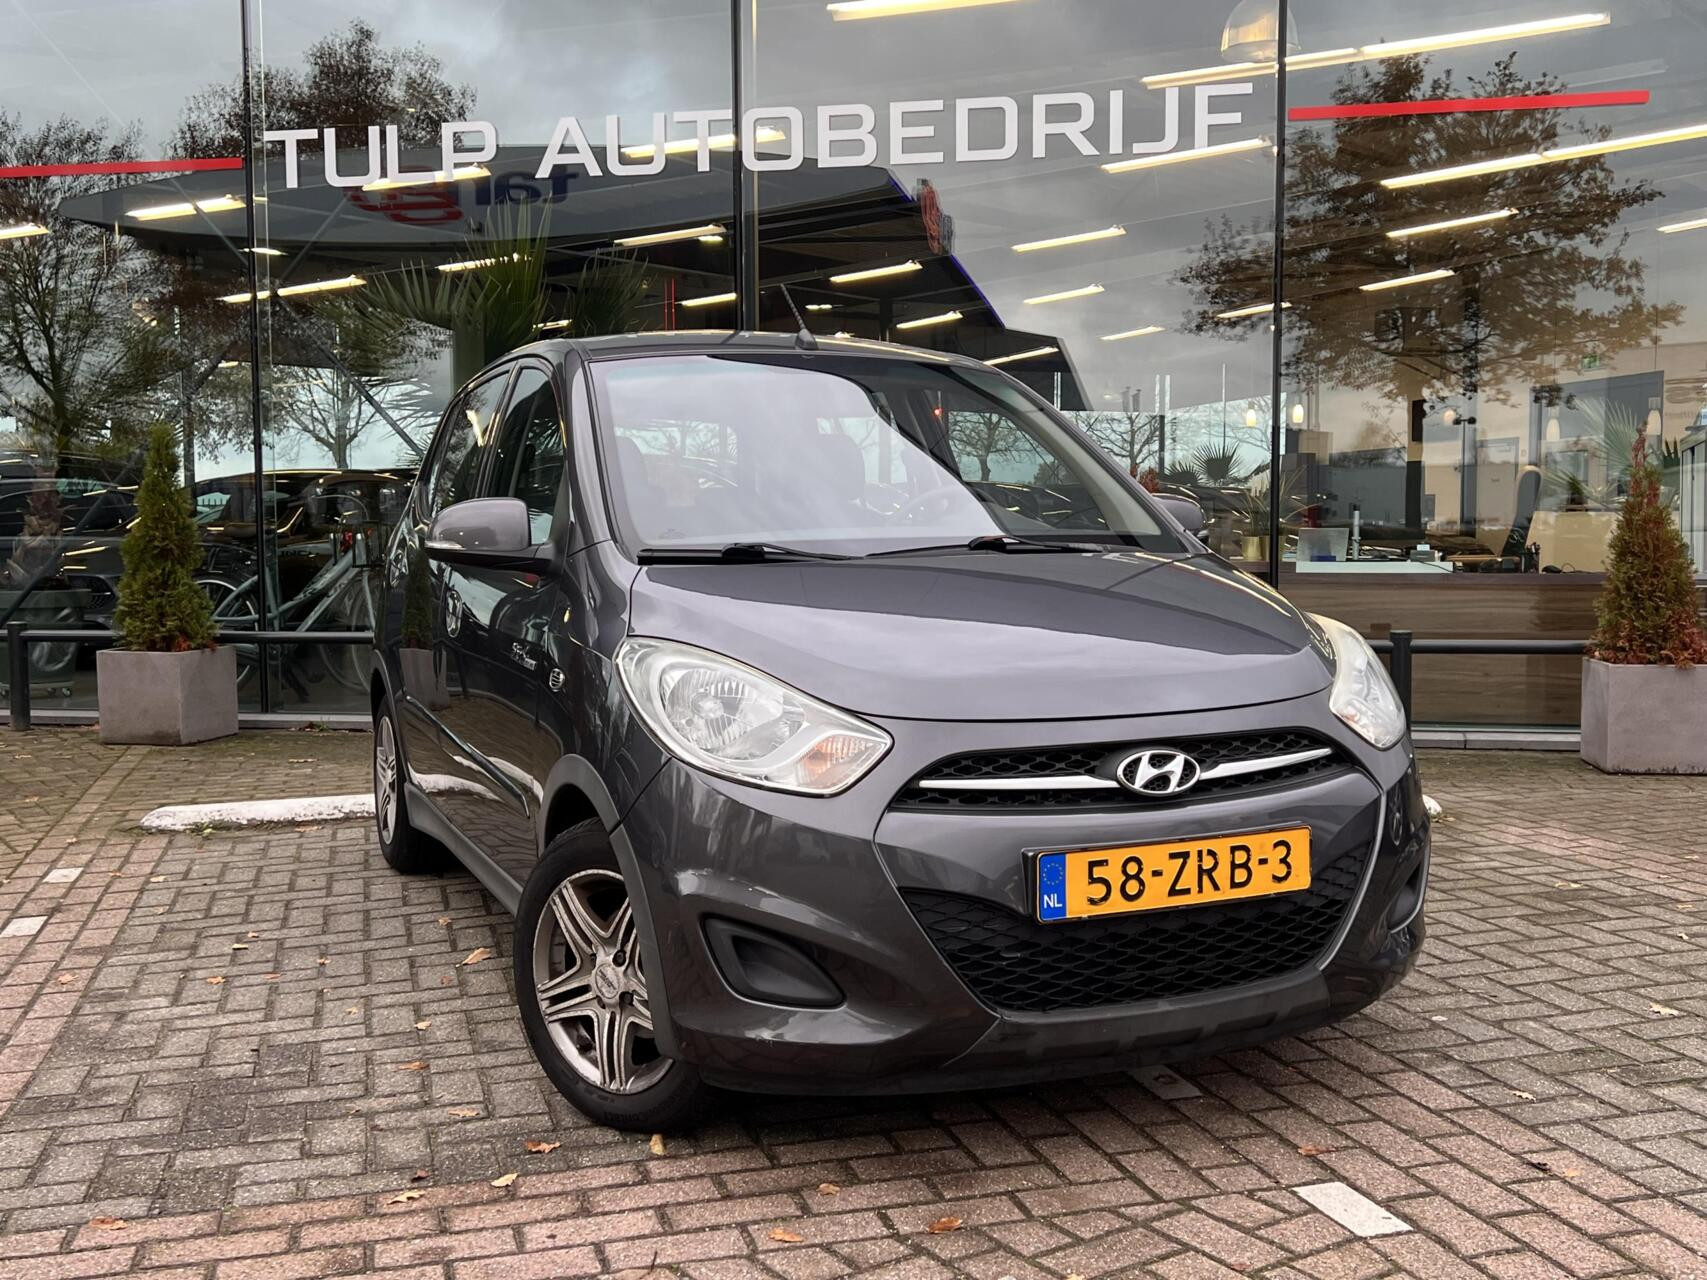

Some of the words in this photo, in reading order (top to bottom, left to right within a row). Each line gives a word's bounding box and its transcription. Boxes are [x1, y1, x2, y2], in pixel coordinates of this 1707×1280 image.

[263, 119, 498, 189] TULP
[534, 82, 1255, 179] AUTOBEDRIJF
[1042, 893, 1063, 909] NL
[1086, 839, 1293, 906] 58-ZRB-3
